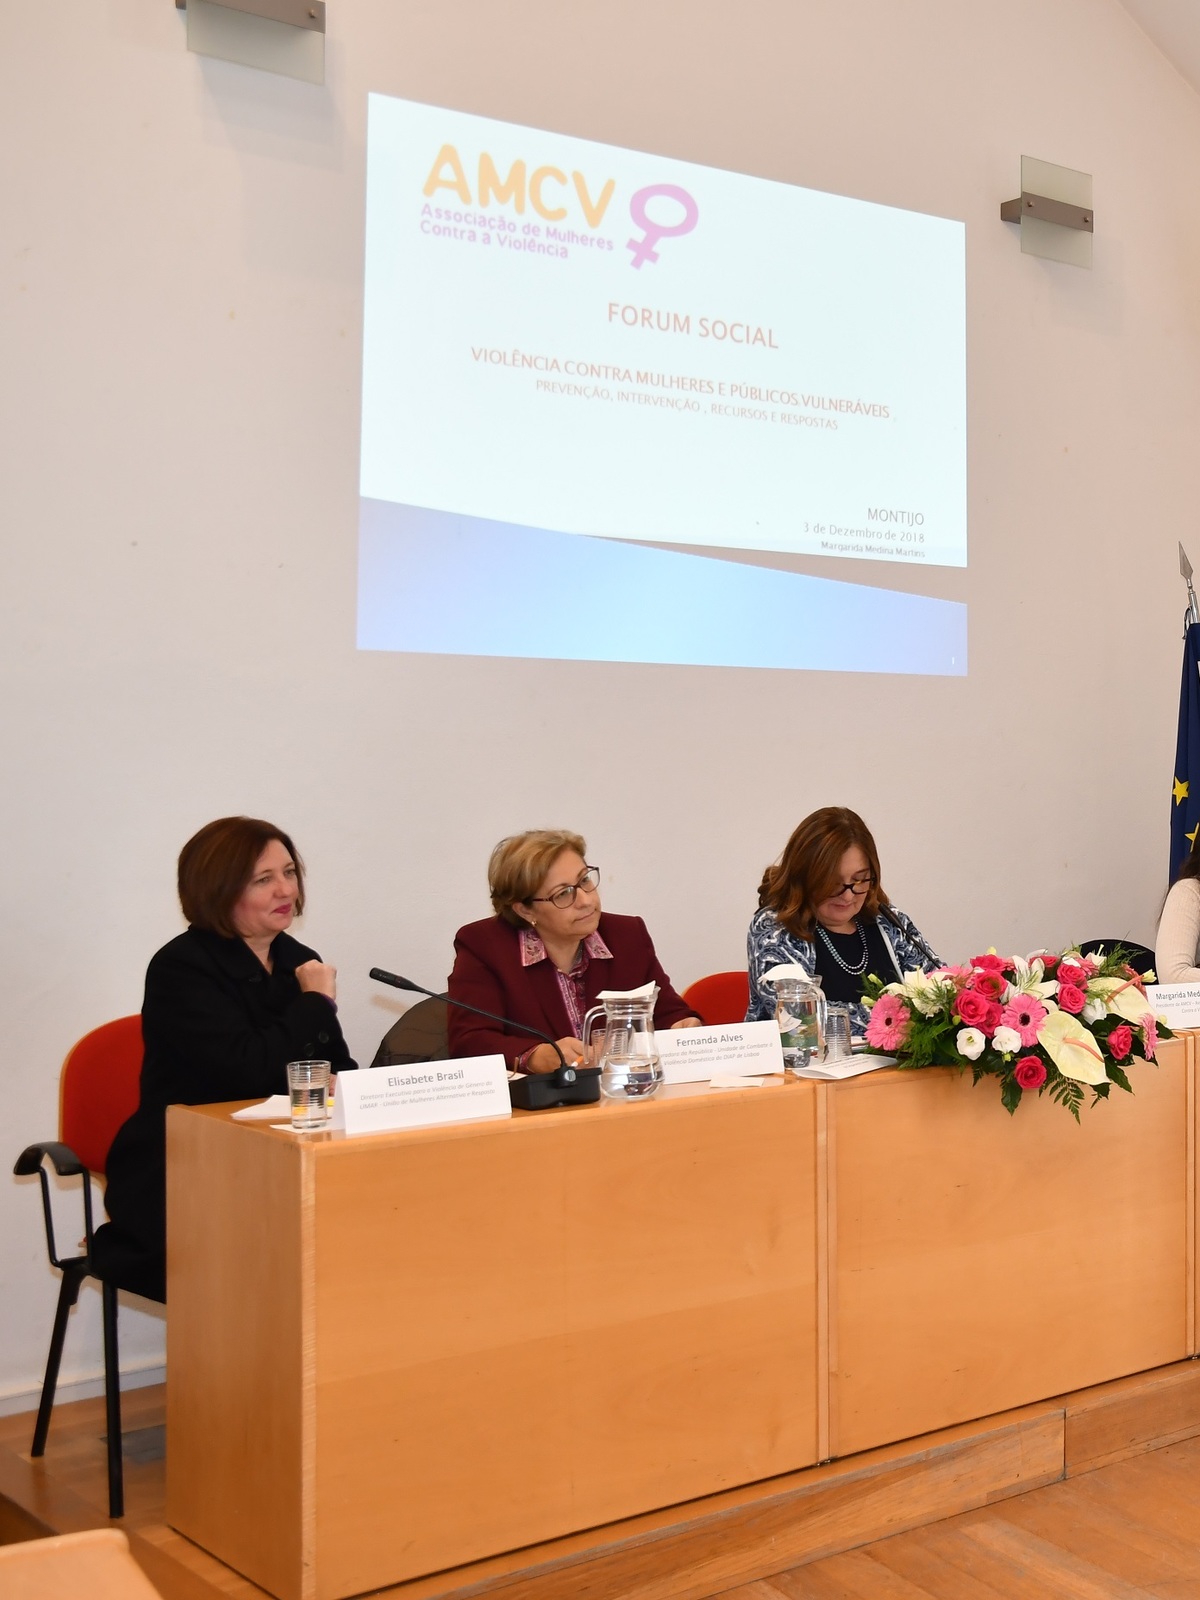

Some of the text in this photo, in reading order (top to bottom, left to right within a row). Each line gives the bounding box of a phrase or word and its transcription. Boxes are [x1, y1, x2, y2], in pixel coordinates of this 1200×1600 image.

[422, 143, 616, 229] AMCV
[419, 219, 569, 259] Contra a Violência
[420, 202, 614, 251] Associação de Mulheres
[607, 302, 779, 349] FORUM SOCIAL
[470, 346, 890, 419] VIOLÊNCIA CONTRA MULHERES E PÚBLICOS VULNERÁVEIS
[711, 403, 768, 421] RECURSOS
[771, 411, 777, 422] E
[780, 412, 839, 431] RESPOSTAS
[867, 508, 925, 527] MONTIJO
[804, 521, 925, 543] 3 de Dezembro de 2018
[820, 541, 925, 558] Margarida Medina Martins
[1156, 991, 1186, 1001] Margarida
[676, 1033, 744, 1047] Fernanda Alves
[387, 1069, 465, 1087] Elisabete Brasil
